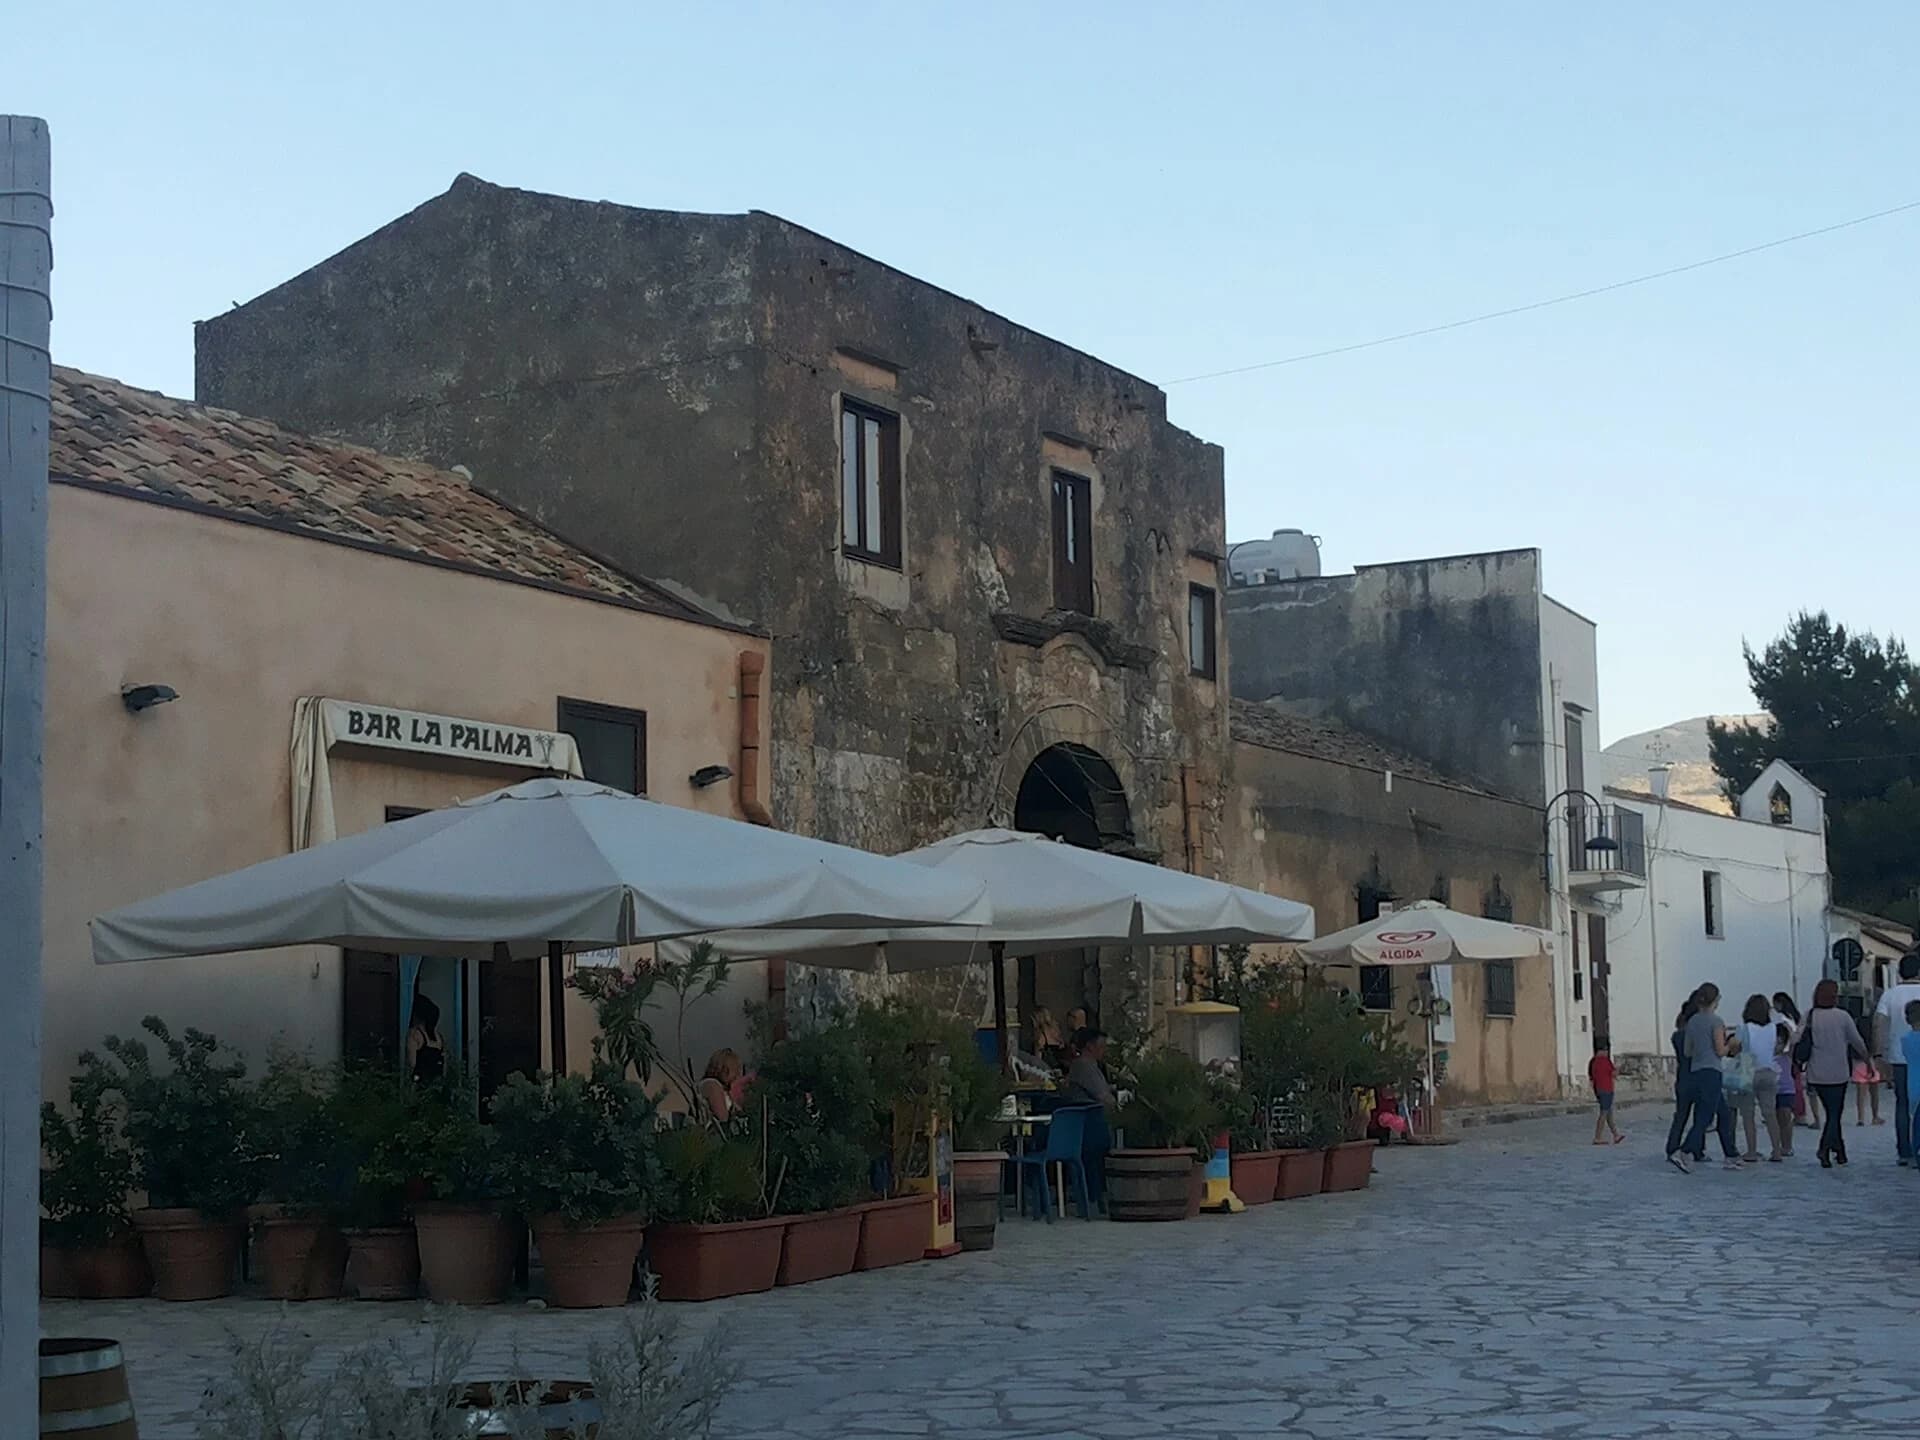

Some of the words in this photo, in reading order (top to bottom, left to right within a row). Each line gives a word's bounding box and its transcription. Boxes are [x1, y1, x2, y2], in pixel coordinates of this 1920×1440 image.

[348, 710, 403, 741] BAR
[411, 719, 443, 747] LA
[450, 723, 534, 758] PALMA
[1379, 949, 1423, 960] ALGIDA
